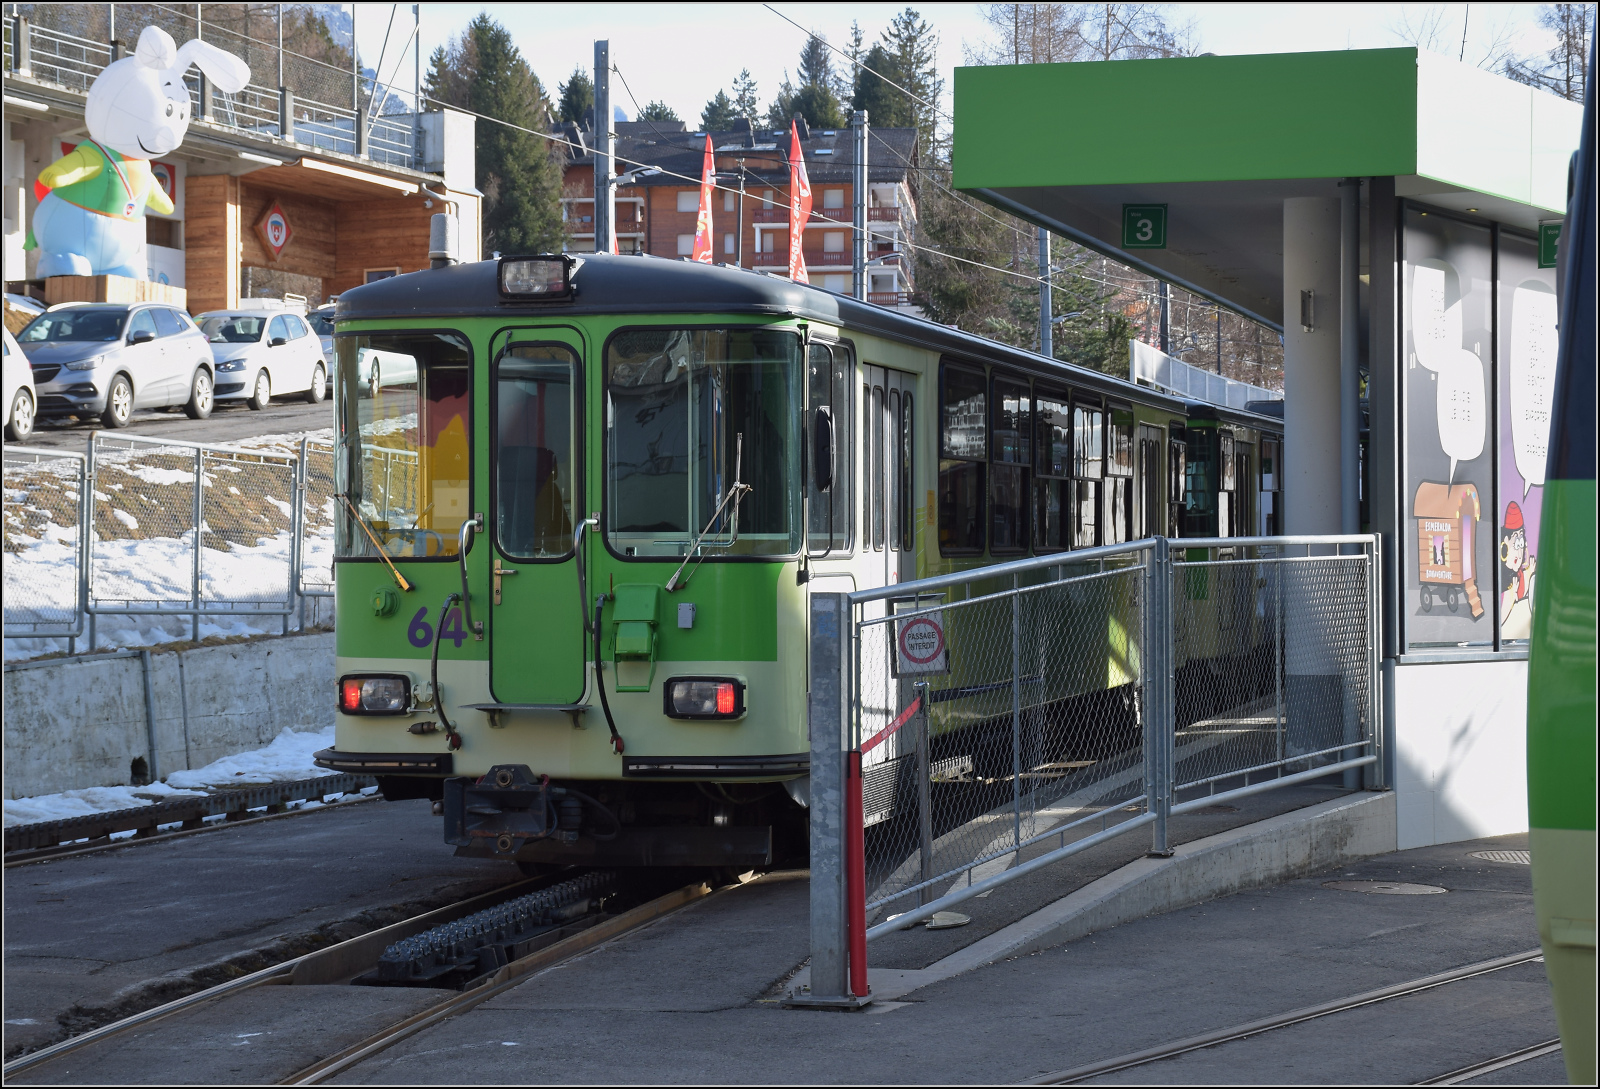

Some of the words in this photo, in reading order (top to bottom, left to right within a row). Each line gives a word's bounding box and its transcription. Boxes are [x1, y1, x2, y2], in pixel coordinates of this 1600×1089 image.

[1135, 218, 1153, 241] 3
[1425, 521, 1452, 532] ESMERALDA
[407, 606, 468, 648] 64
[907, 631, 936, 641] PASSAGE
[908, 642, 936, 651] INTERDIT
